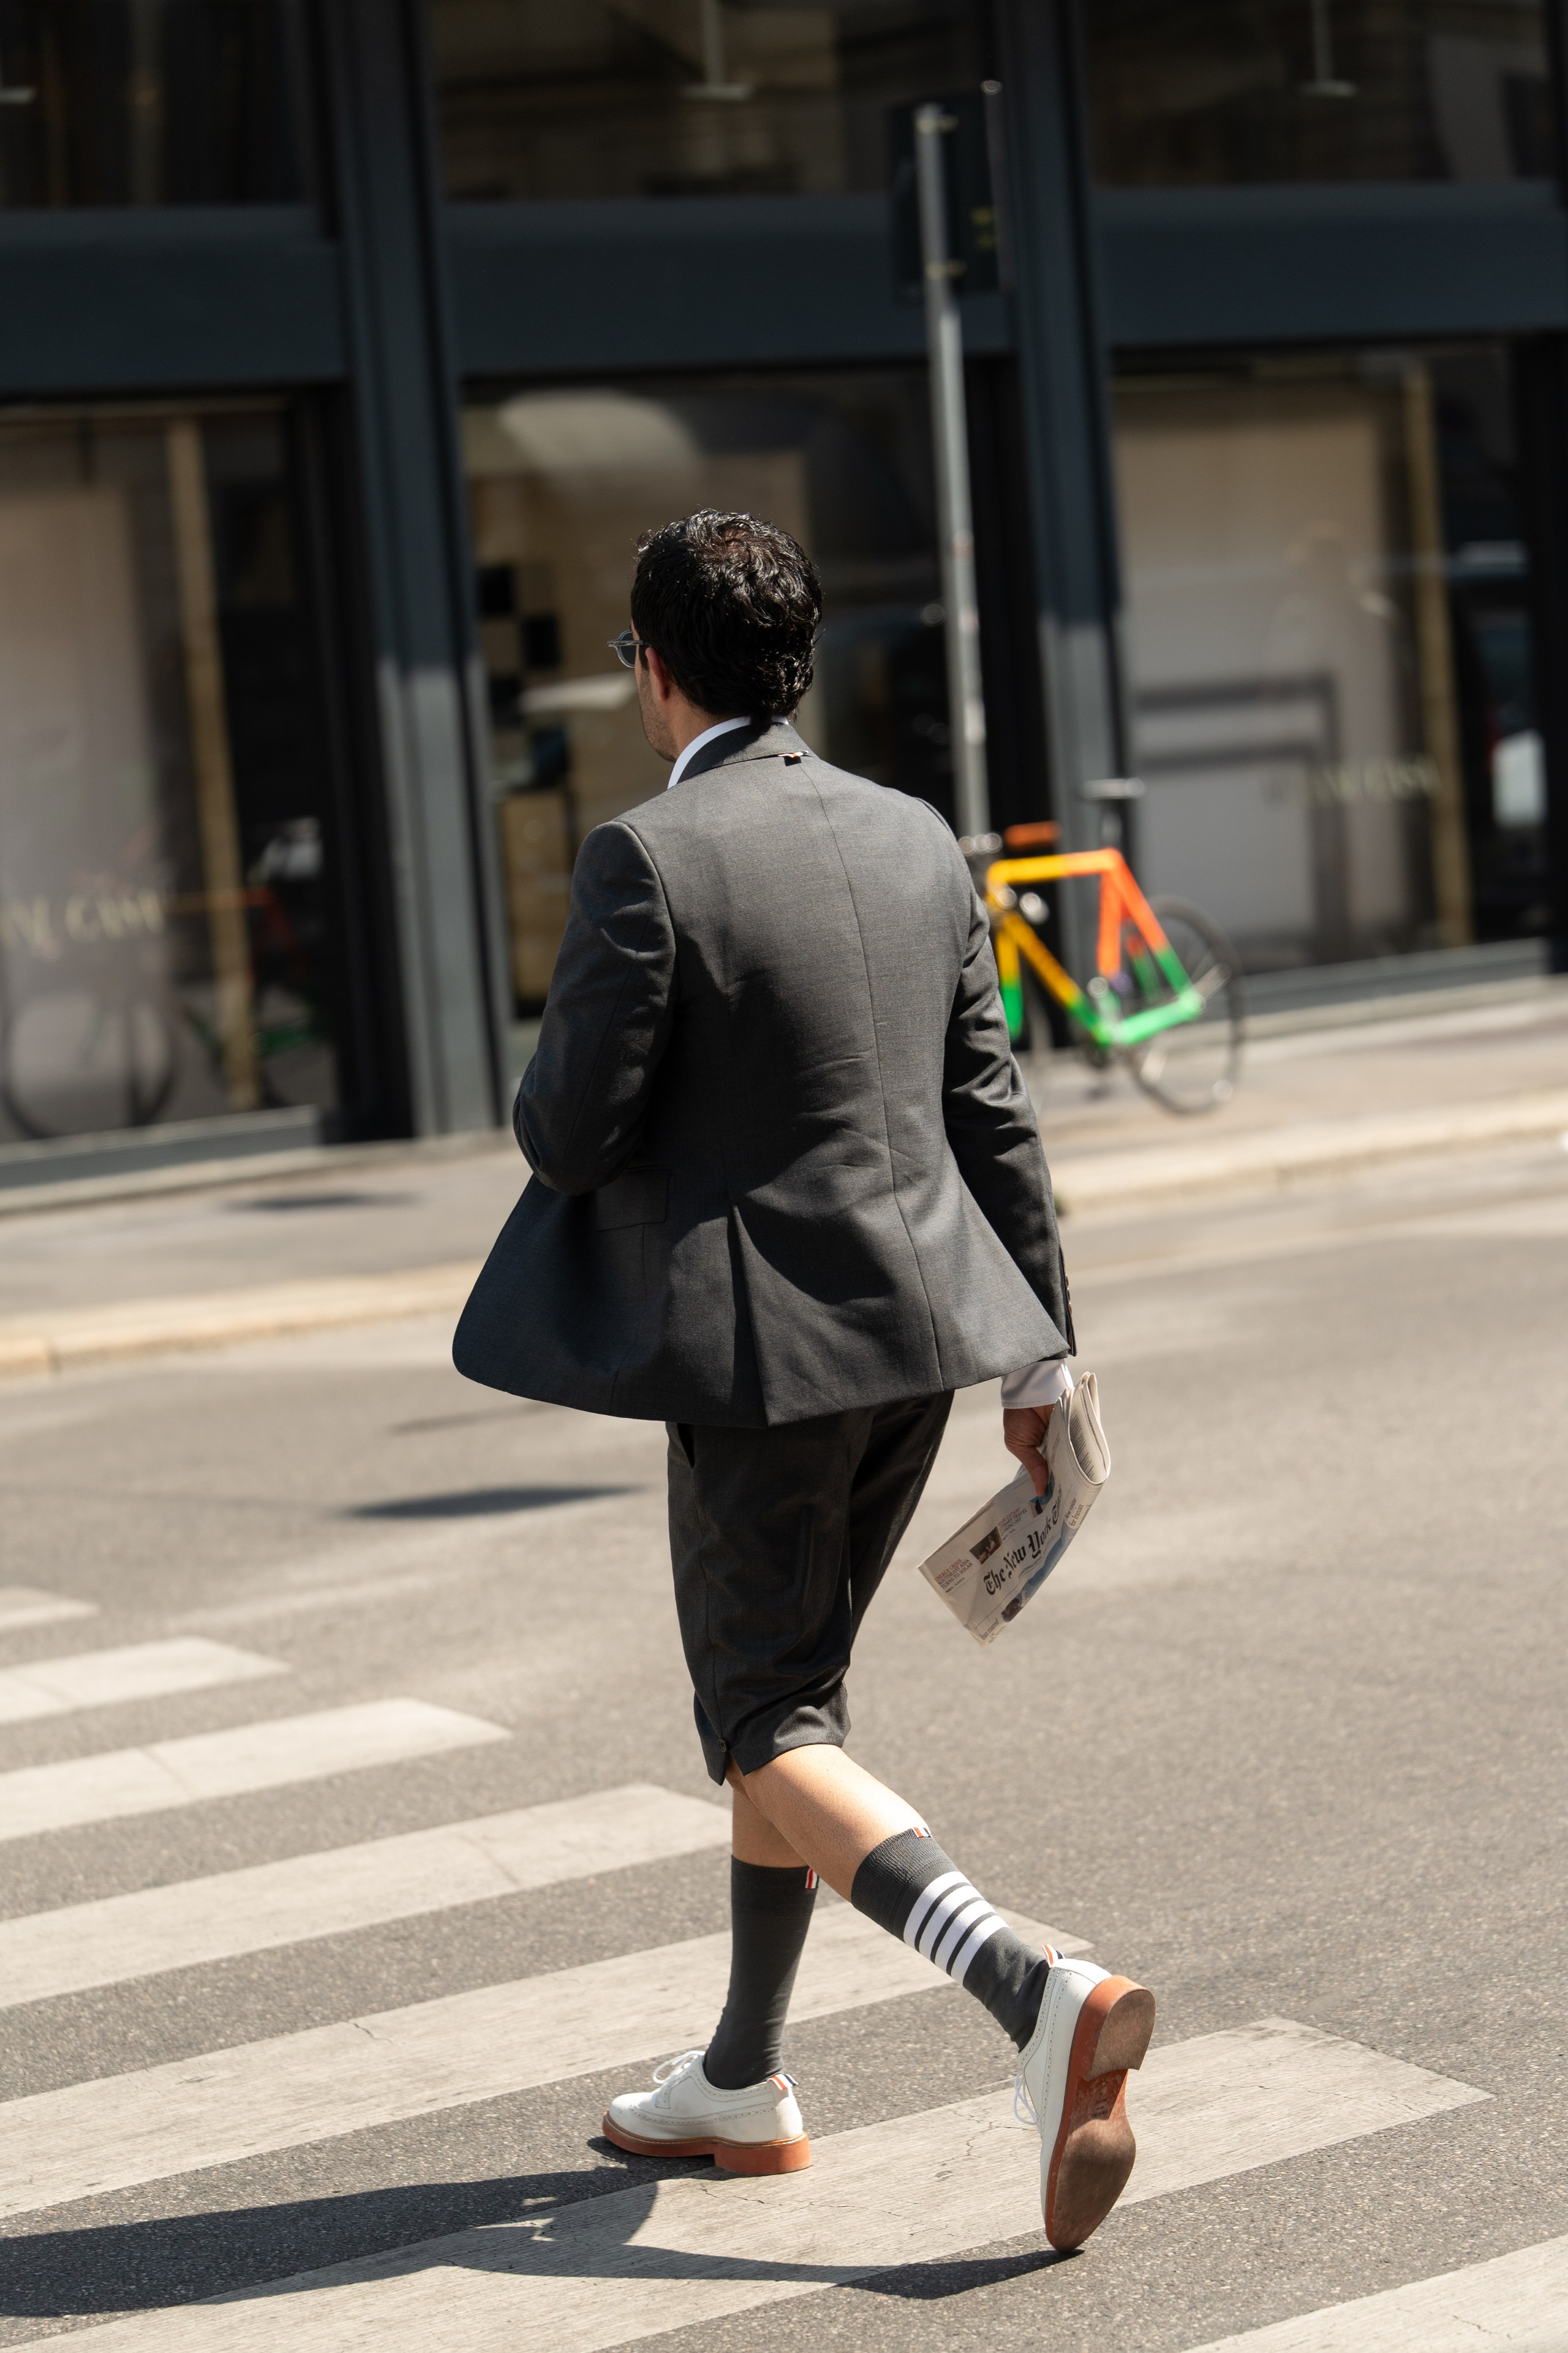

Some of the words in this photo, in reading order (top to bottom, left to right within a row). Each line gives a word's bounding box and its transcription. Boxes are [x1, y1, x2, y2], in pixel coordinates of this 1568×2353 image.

[1072, 1504, 1084, 1520] Iranian
[983, 1569, 1006, 1595] The
[1003, 1546, 1027, 1579] New
[1027, 1515, 1052, 1559] York
[934, 1568, 950, 1582] ENERGY
[949, 1558, 962, 1570] CRISIS
[938, 1566, 960, 1585] SOUTHEAST
[960, 1559, 970, 1568] ASIA
[941, 1577, 955, 1589] TURNS
[959, 1562, 974, 1574] SOLAR
